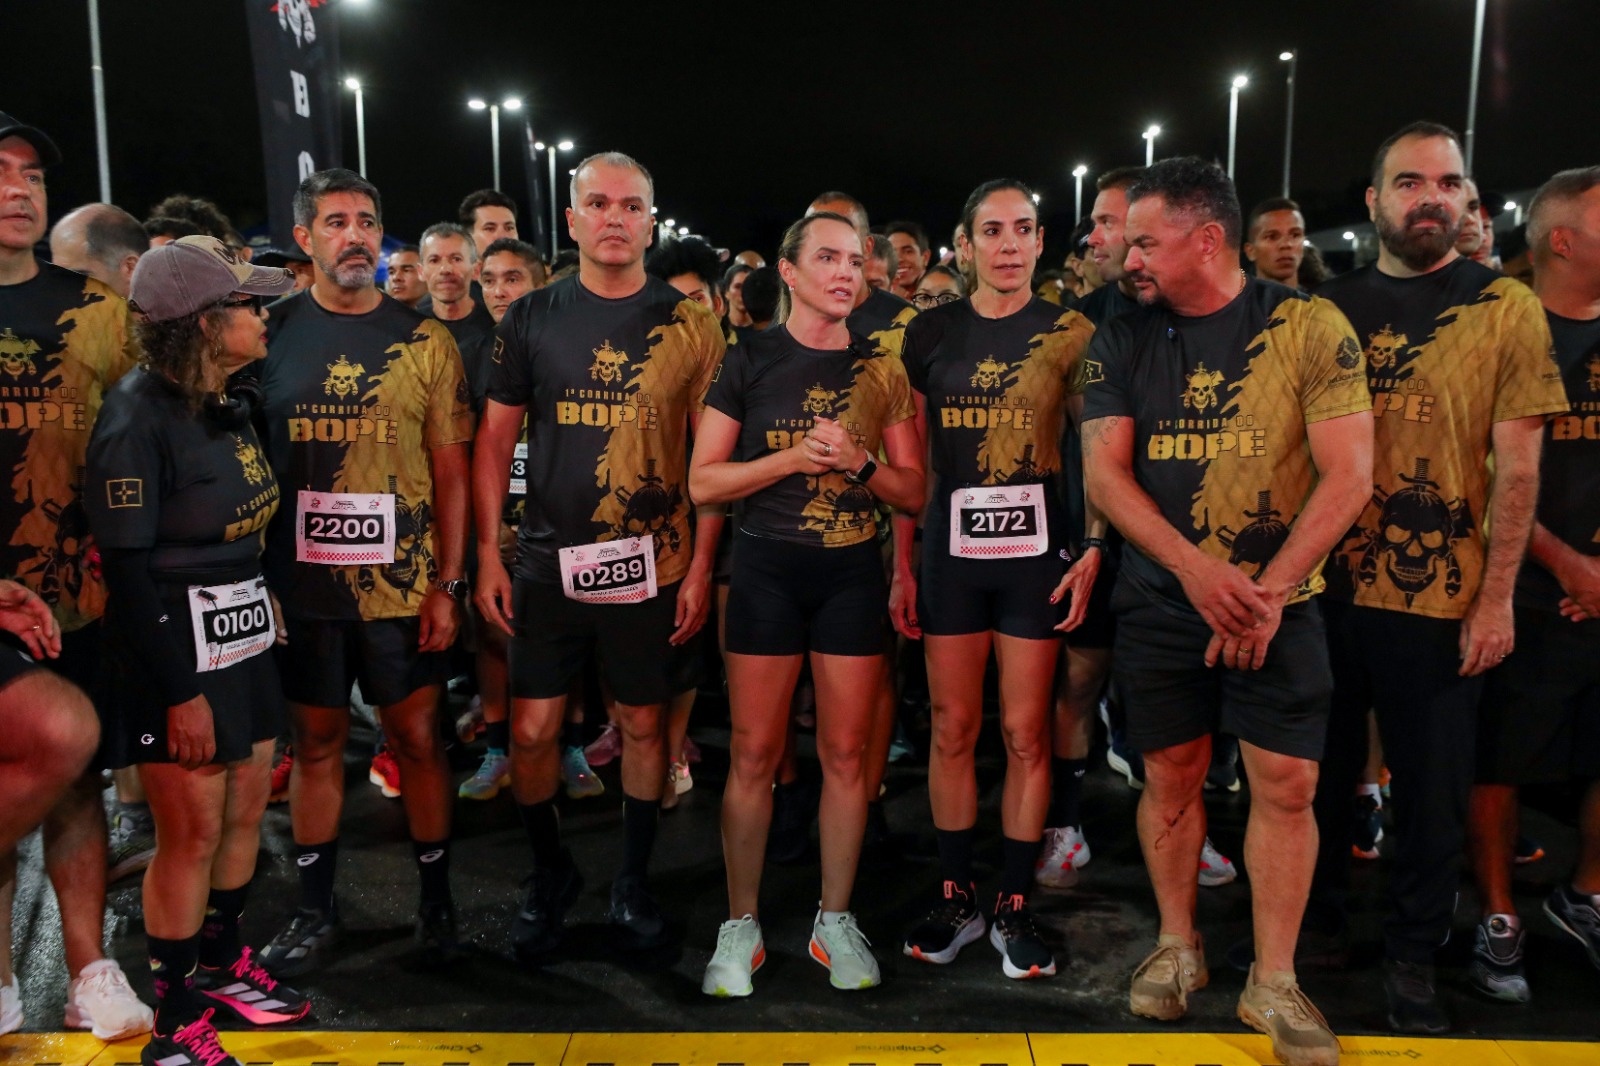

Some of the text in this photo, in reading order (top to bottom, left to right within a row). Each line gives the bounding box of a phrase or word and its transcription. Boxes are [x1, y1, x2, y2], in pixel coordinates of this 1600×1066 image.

[579, 389, 631, 402] CORRIDA
[1370, 378, 1401, 389] RIDA
[0, 401, 86, 431] OPE
[311, 404, 369, 415] CORRIDA
[556, 401, 658, 431] BOPE
[941, 406, 1035, 431] BOPE
[1374, 392, 1435, 424] PE
[288, 417, 398, 444] BOPE
[1552, 415, 1600, 440] BO
[1147, 428, 1267, 461] BOPE
[310, 517, 380, 539] 2200
[971, 510, 1027, 532] 2172
[578, 559, 643, 587] 0289
[213, 605, 265, 638] 0100
